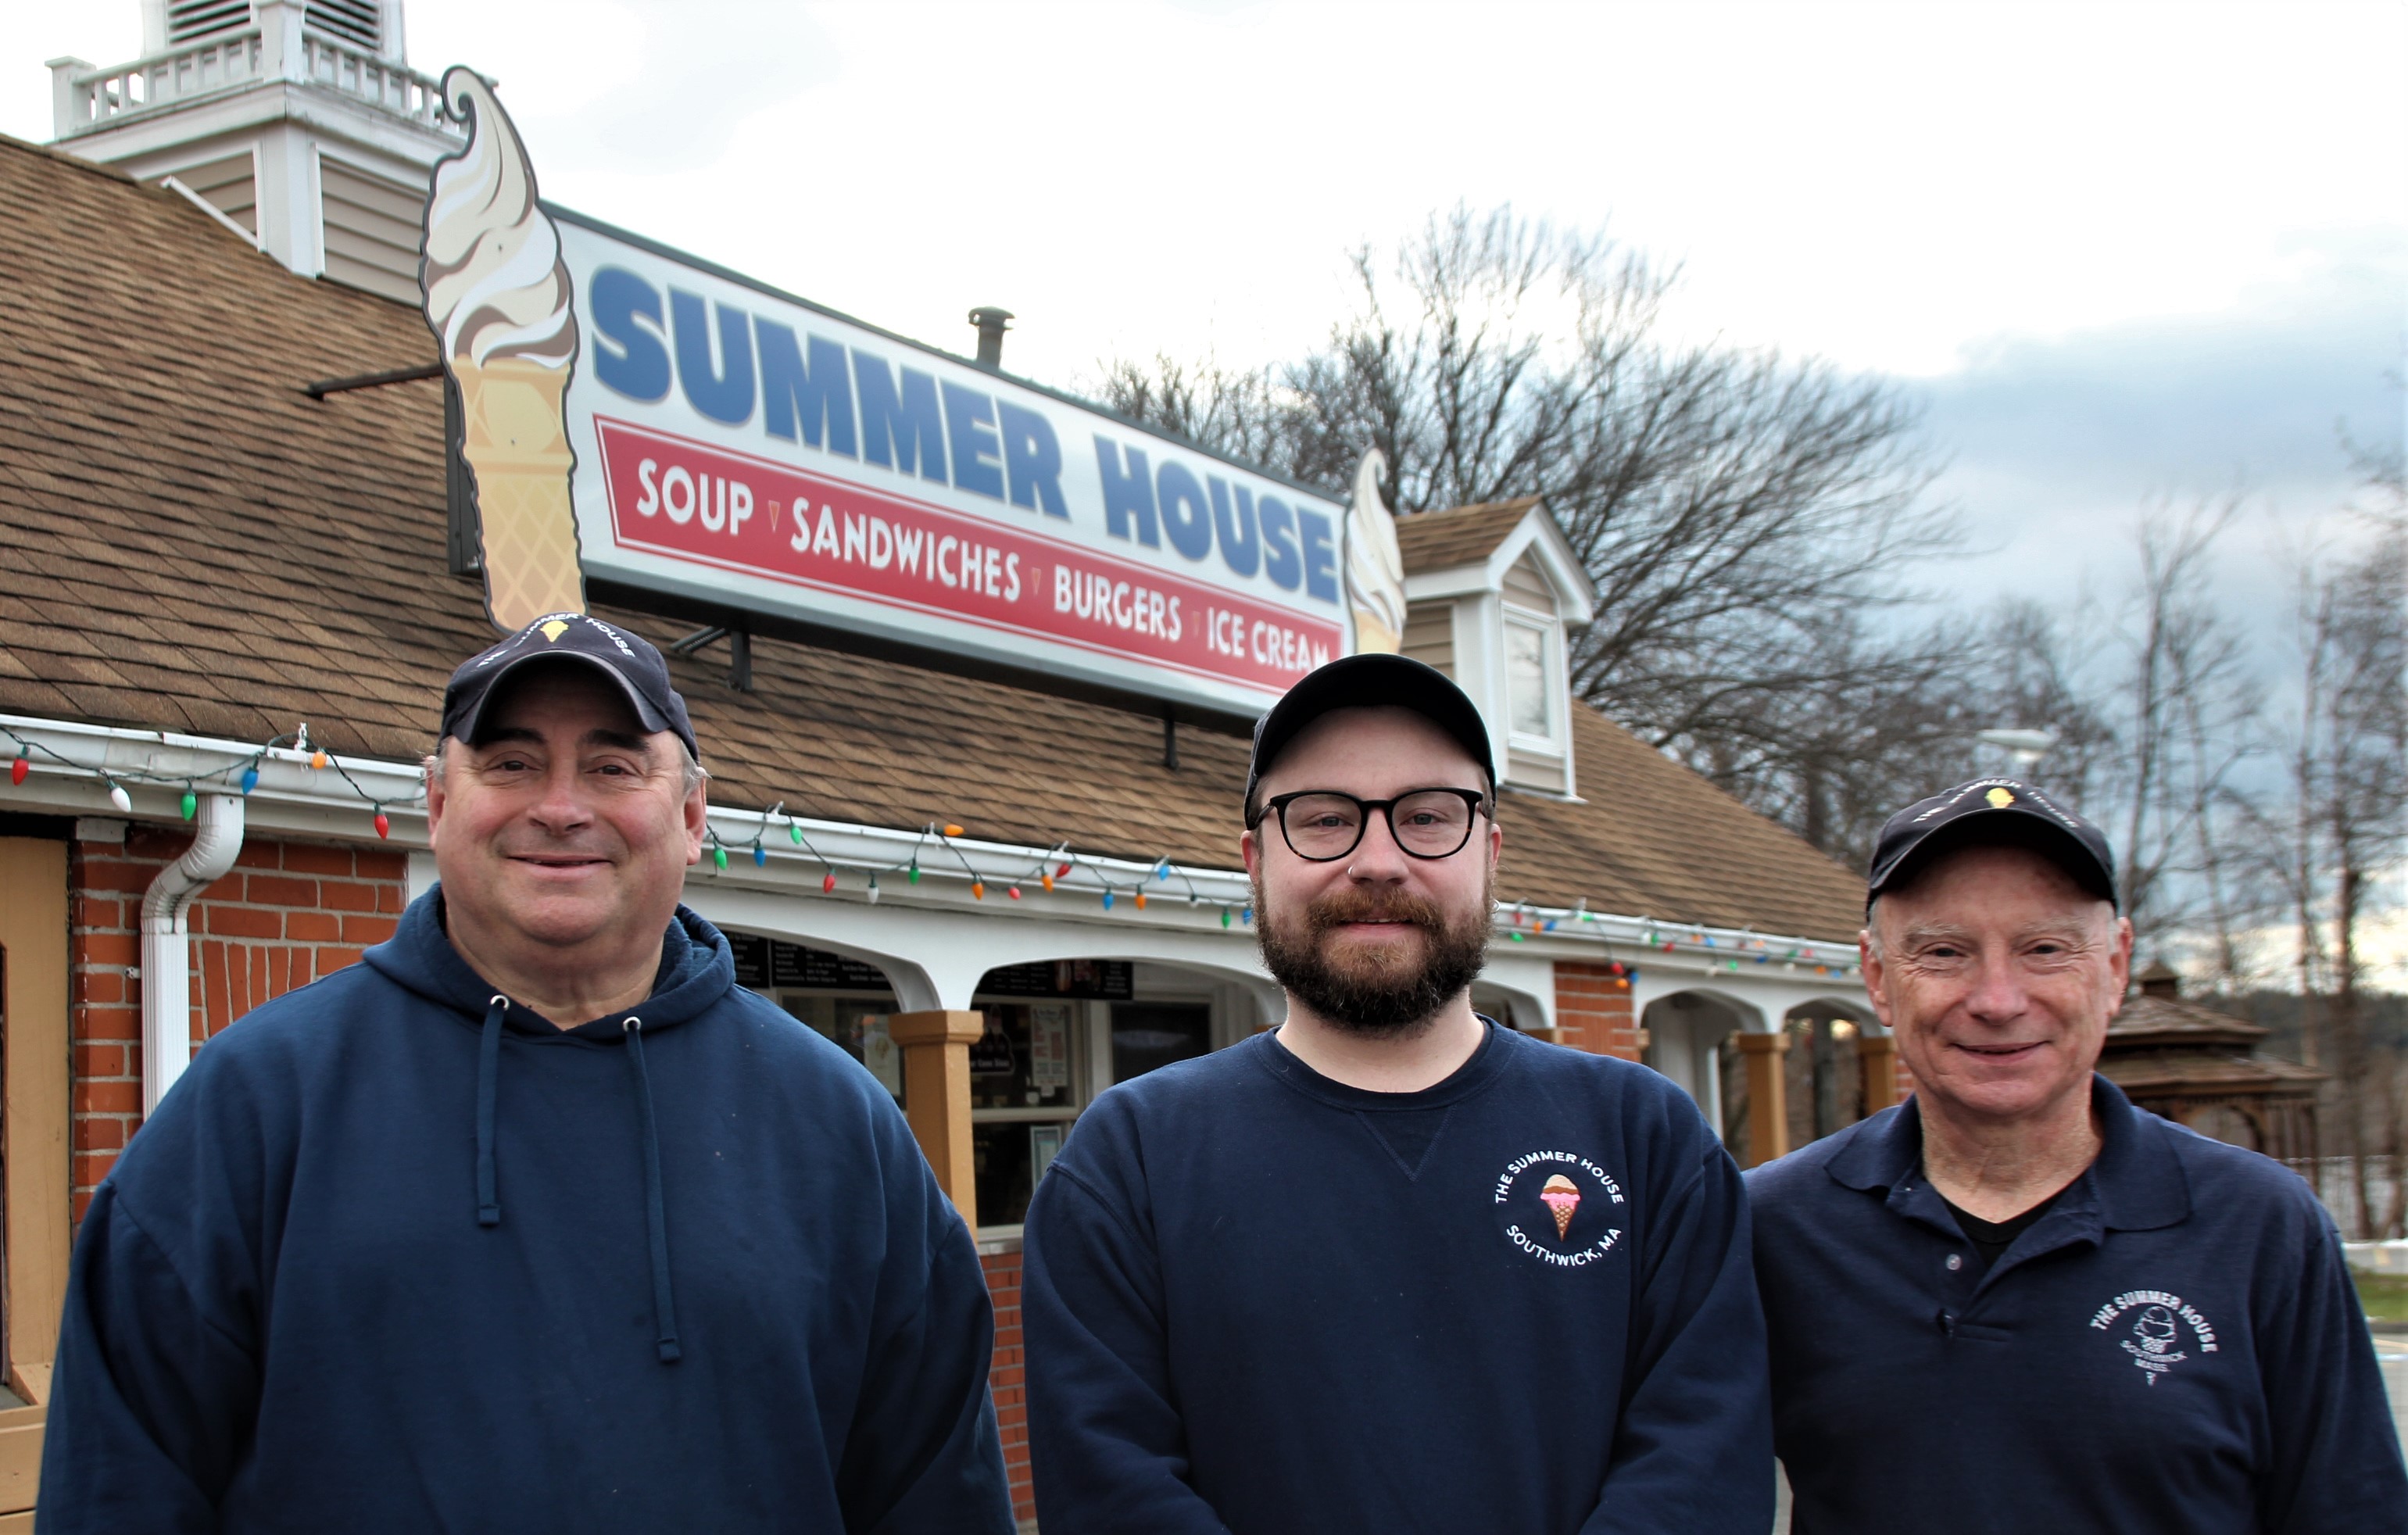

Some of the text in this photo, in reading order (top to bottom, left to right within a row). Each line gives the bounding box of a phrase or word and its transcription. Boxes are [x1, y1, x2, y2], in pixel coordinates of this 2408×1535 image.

[589, 263, 1339, 605] SUMMER HOUSE
[636, 458, 1329, 673] SOUP SANDWICHES BURGERS ICE CREAM
[585, 617, 635, 658] HOUSE
[1494, 1150, 1624, 1204] THE SUMMER HOUSE
[1506, 1225, 1622, 1266] SOUTHWICK, MA
[2089, 1290, 2219, 1352] THE SUMMER HOUSE
